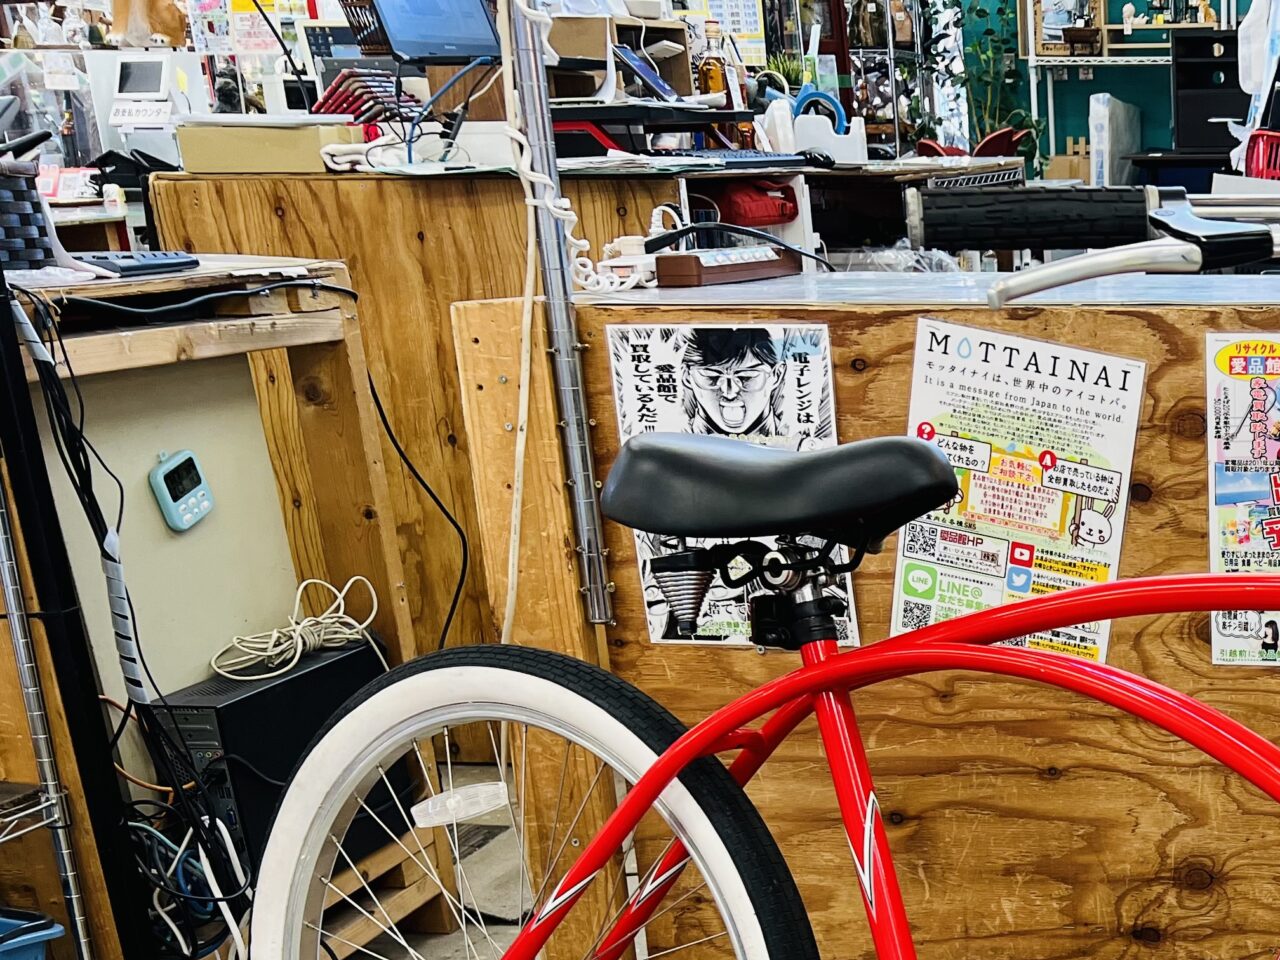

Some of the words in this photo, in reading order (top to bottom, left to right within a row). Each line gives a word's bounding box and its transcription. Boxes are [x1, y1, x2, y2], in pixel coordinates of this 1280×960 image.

[1235, 343, 1277, 354] リサイクル
[654, 363, 679, 404] 愛品館で
[791, 351, 815, 424] 電子レンジは
[926, 361, 1127, 409] モッタイナイは、世界中のアイコトバ。
[924, 375, 934, 384] It
[937, 378, 946, 387] is
[959, 384, 1001, 399] message
[1004, 391, 1027, 404] from
[1031, 396, 1058, 411] Japan
[1062, 404, 1072, 414] to
[1075, 406, 1091, 417] the
[937, 438, 975, 454] どんな物を
[947, 454, 986, 468] てくれるの？
[1000, 459, 1032, 473] お気軽に
[991, 467, 1038, 482] ご相談下さい
[1053, 464, 1114, 484] お店で売っている物は
[939, 529, 984, 547] 愛品館HP
[911, 575, 929, 585] LINE
[938, 581, 983, 599] LINE@
